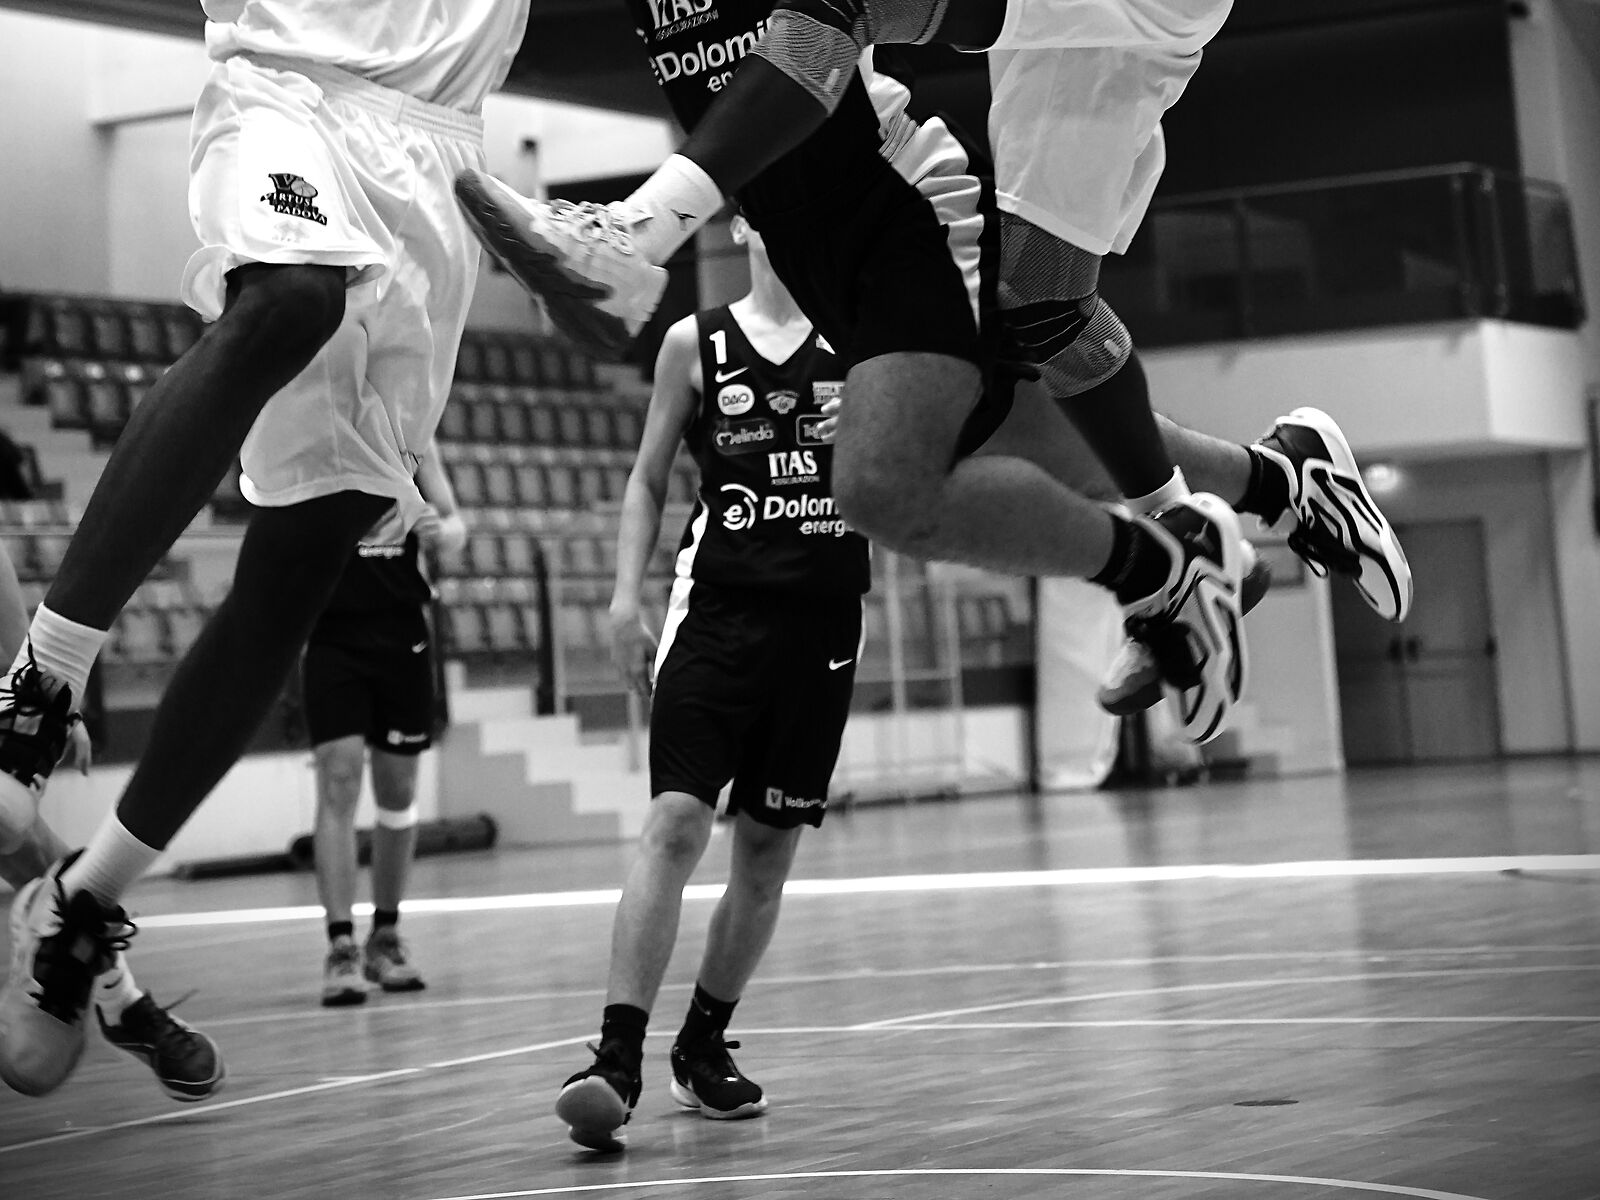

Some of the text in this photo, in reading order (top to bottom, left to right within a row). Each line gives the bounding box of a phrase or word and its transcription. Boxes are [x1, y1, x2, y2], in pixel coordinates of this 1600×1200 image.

[277, 204, 326, 224] PADOVA
[709, 330, 727, 364] 1
[768, 450, 817, 477] ITAS
[800, 518, 847, 537] energ
